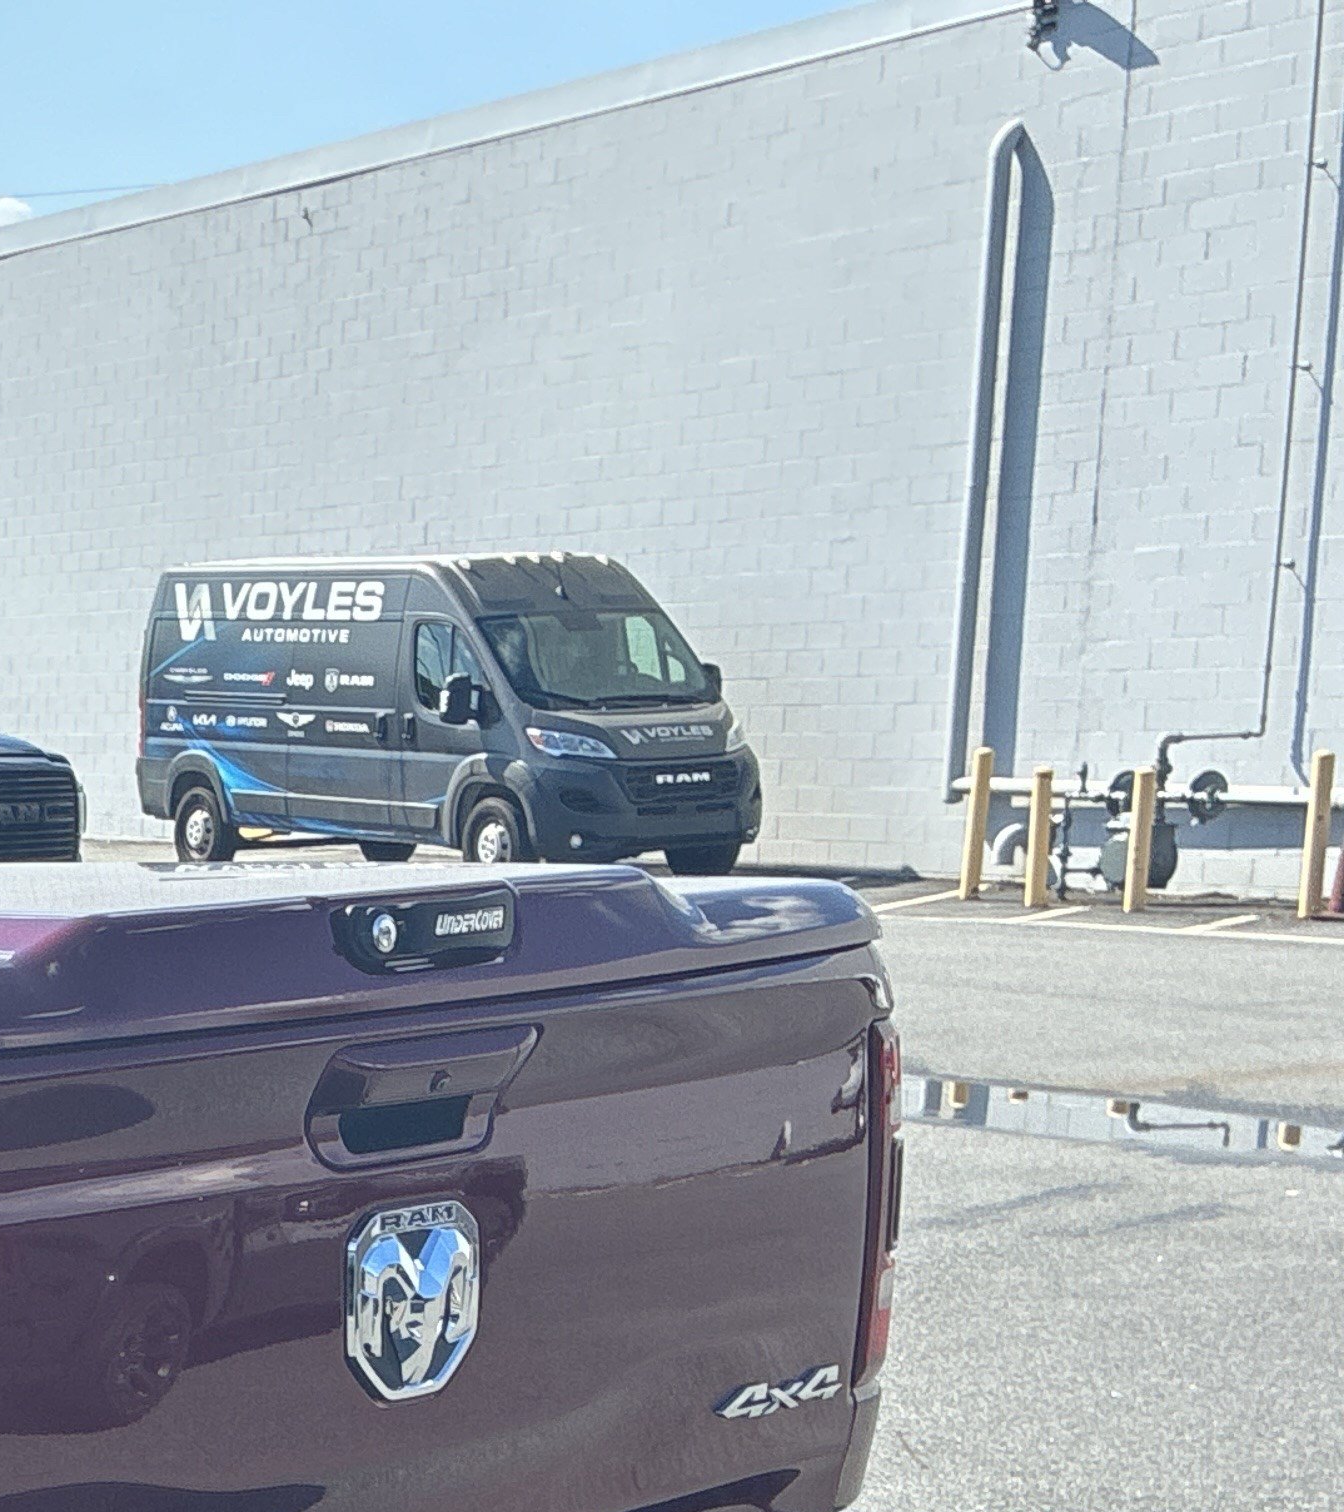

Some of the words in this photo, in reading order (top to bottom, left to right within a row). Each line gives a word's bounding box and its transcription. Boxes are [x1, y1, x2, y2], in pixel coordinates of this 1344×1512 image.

[222, 581, 386, 621] VOYLES
[241, 627, 350, 644] AUTOMOTIVE
[286, 668, 314, 691] Jeep
[339, 674, 375, 687] RAM
[643, 724, 714, 738] VOYLES
[655, 771, 712, 785] RAM
[378, 1204, 456, 1231] RAM
